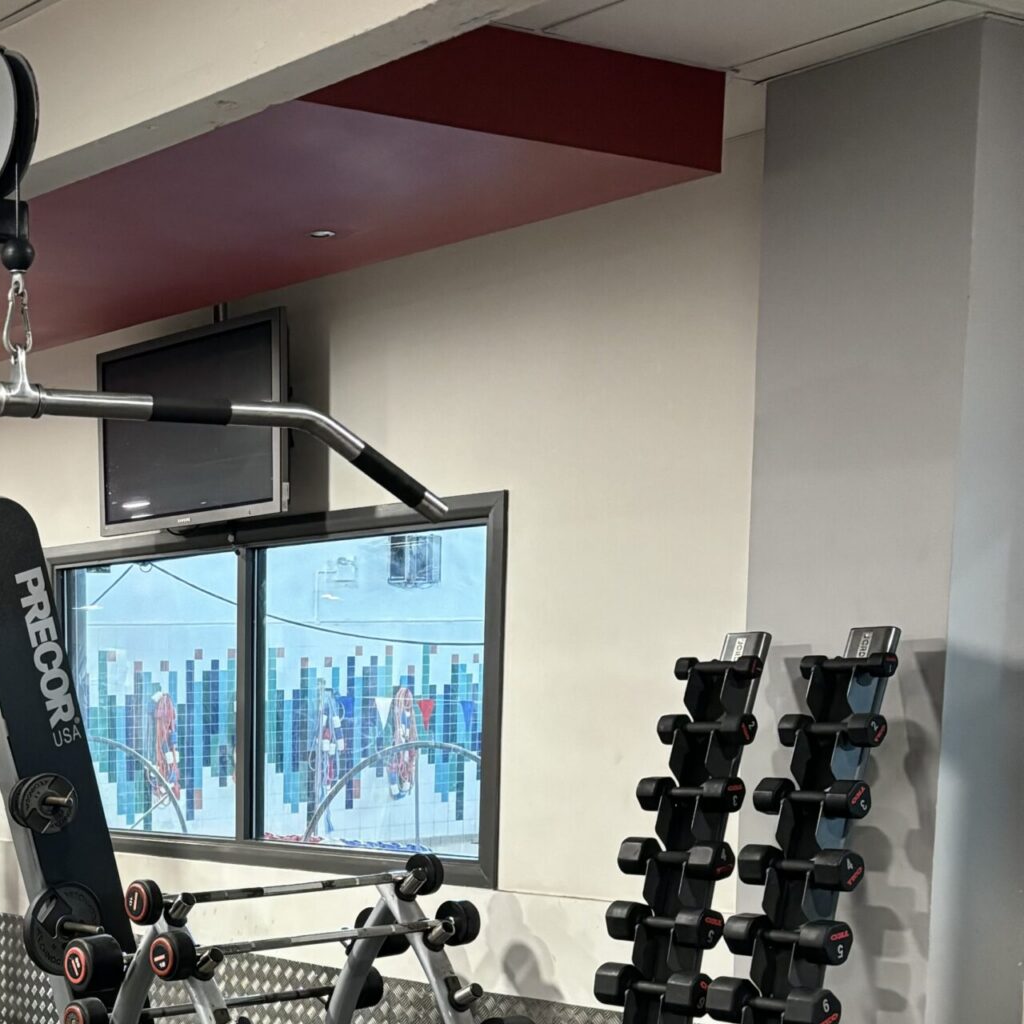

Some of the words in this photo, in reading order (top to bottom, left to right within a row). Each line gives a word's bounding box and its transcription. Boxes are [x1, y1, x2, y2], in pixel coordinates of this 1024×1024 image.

[15, 566, 75, 729] PRECOR
[53, 725, 82, 747] USA
[733, 795, 738, 807] 3
[859, 799, 868, 811] 3
[846, 858, 853, 870] 4
[707, 929, 715, 943] 5
[837, 944, 844, 959] 5
[822, 999, 830, 1012] 6
